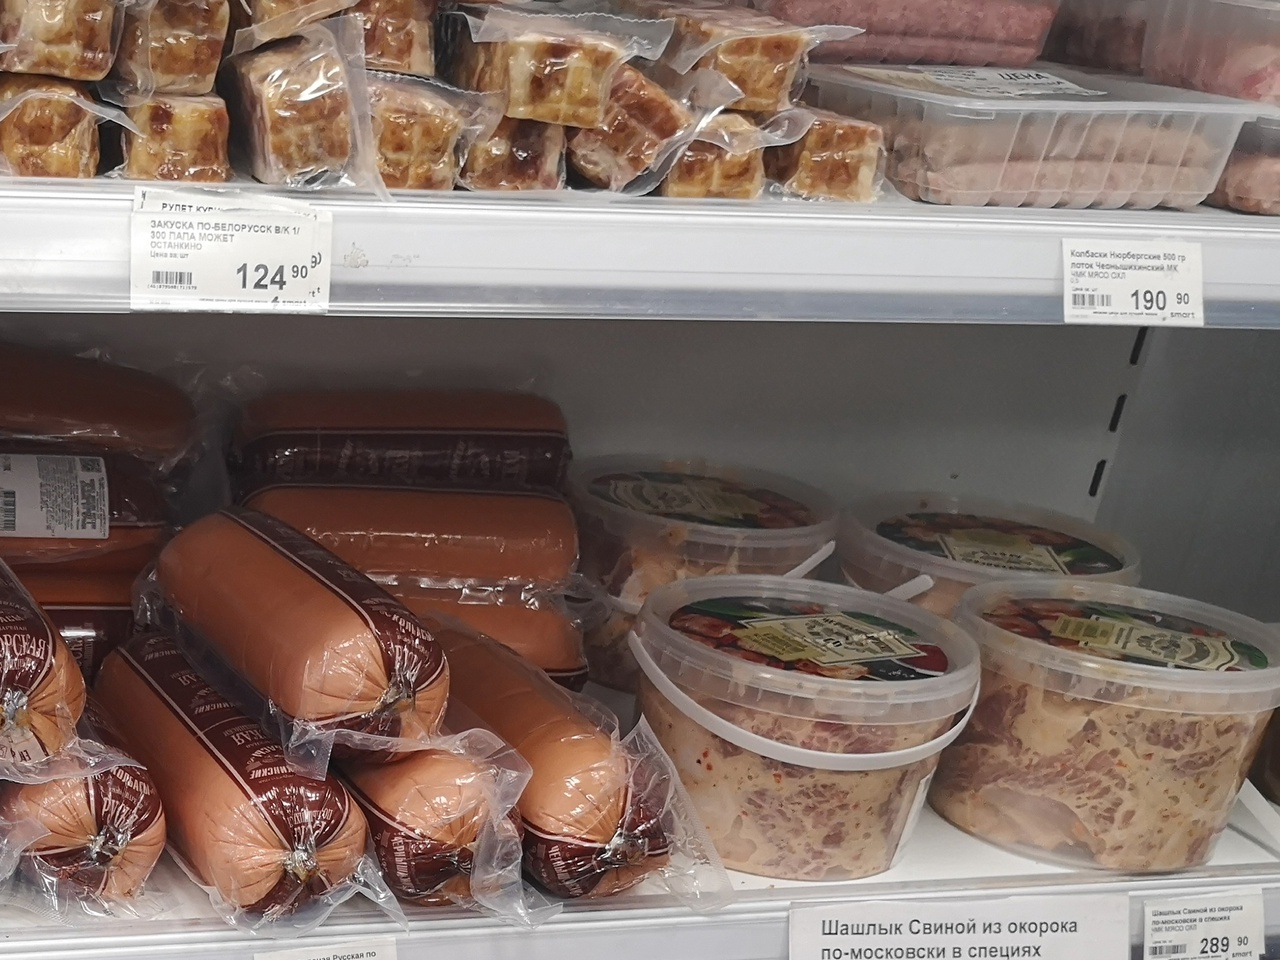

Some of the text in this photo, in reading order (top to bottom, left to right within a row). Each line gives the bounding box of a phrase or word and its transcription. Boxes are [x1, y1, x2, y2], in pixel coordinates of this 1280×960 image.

[150, 220, 194, 231] ЗАКУСКА
[197, 222, 272, 234] ПО-БЕЛОРУССК
[150, 231, 235, 243] 300 ПАПА МОЖЕТ
[150, 241, 203, 251] ОСТАНКИНО
[1163, 253, 1176, 261] 500
[236, 263, 308, 291] 124 90
[1131, 290, 1190, 311] 190 90
[1170, 311, 1195, 319] smart
[822, 918, 1078, 937] Шашлык Свиной из окорока
[1200, 936, 1248, 955] 289 90
[366, 951, 377, 959] по
[951, 948, 963, 959] в
